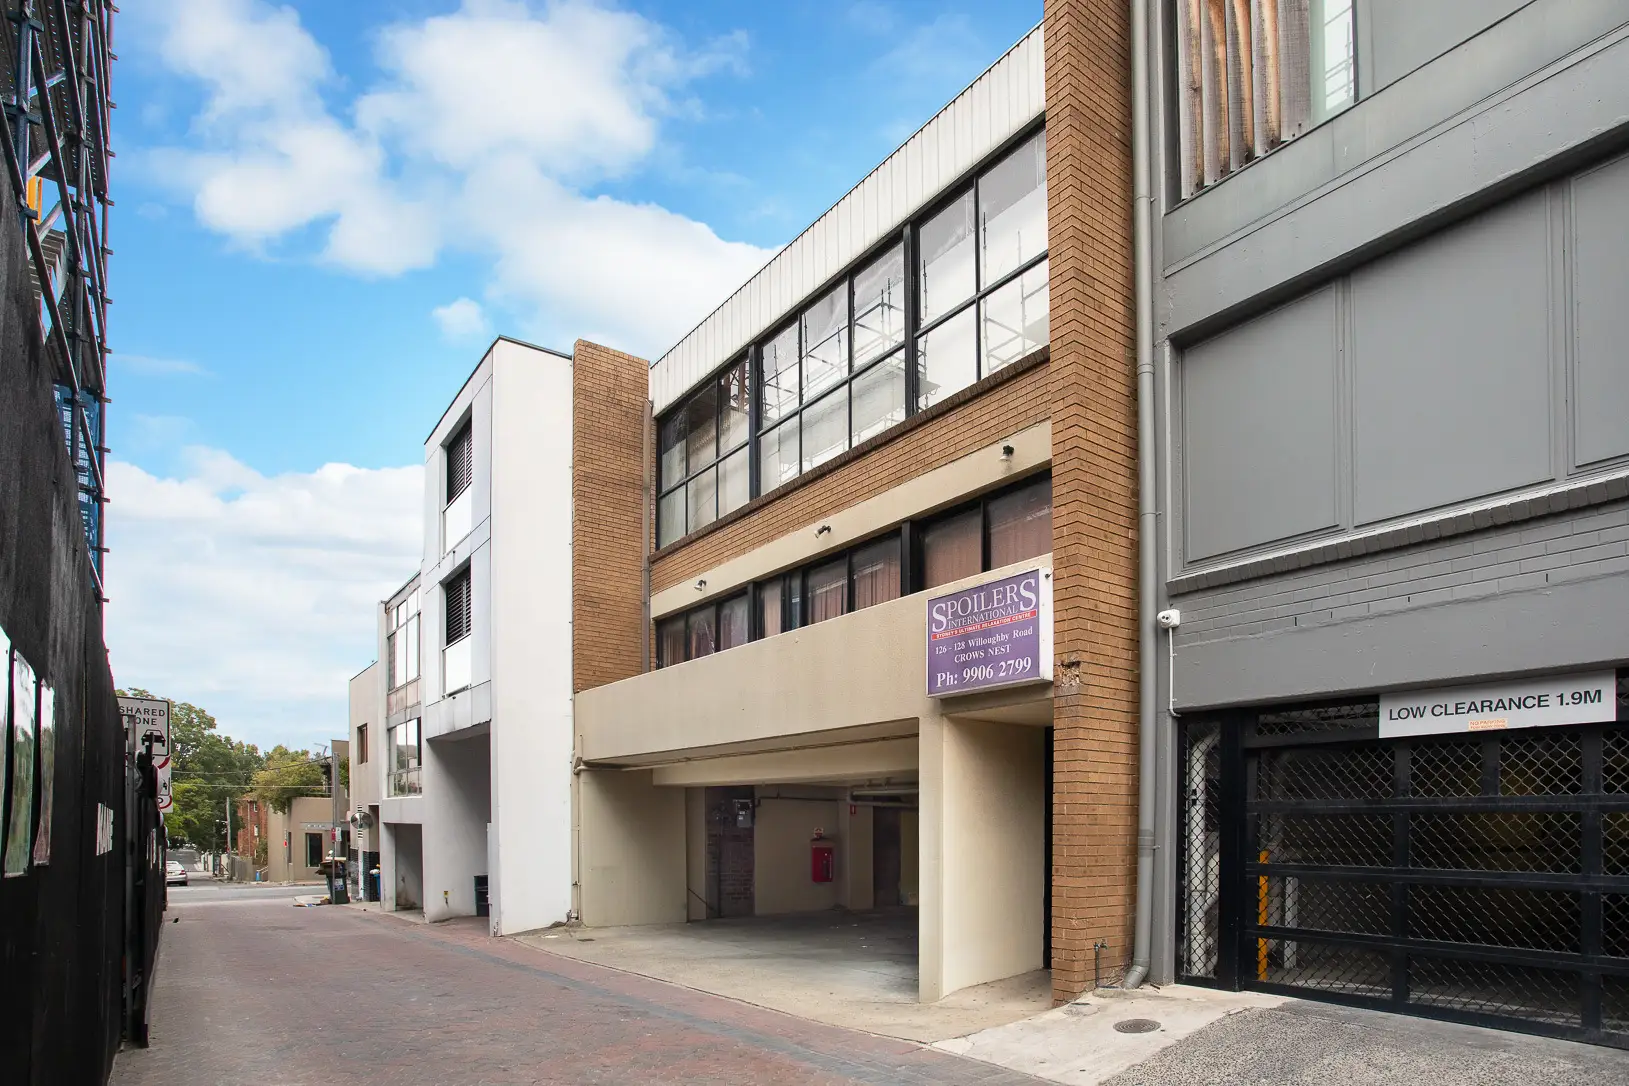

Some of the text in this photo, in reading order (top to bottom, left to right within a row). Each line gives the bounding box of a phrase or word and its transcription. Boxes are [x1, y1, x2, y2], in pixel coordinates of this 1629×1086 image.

[932, 578, 1037, 633] SPOILERS
[947, 605, 1019, 630] INTERNATIONAL
[958, 624, 980, 634] ULTIMATE
[981, 617, 1011, 629] RELAXATION
[1012, 611, 1031, 621] CENTRE
[935, 645, 947, 655] 126
[954, 641, 966, 652] 128
[968, 632, 1010, 648] Willoughby
[1013, 626, 1033, 638] Road
[954, 644, 1012, 663] CROWS NEST
[936, 656, 1032, 688] Ph: 9906 2799
[119, 705, 166, 717] SHARED
[1388, 688, 1603, 721] LOW CLEARANCE 1.9M
